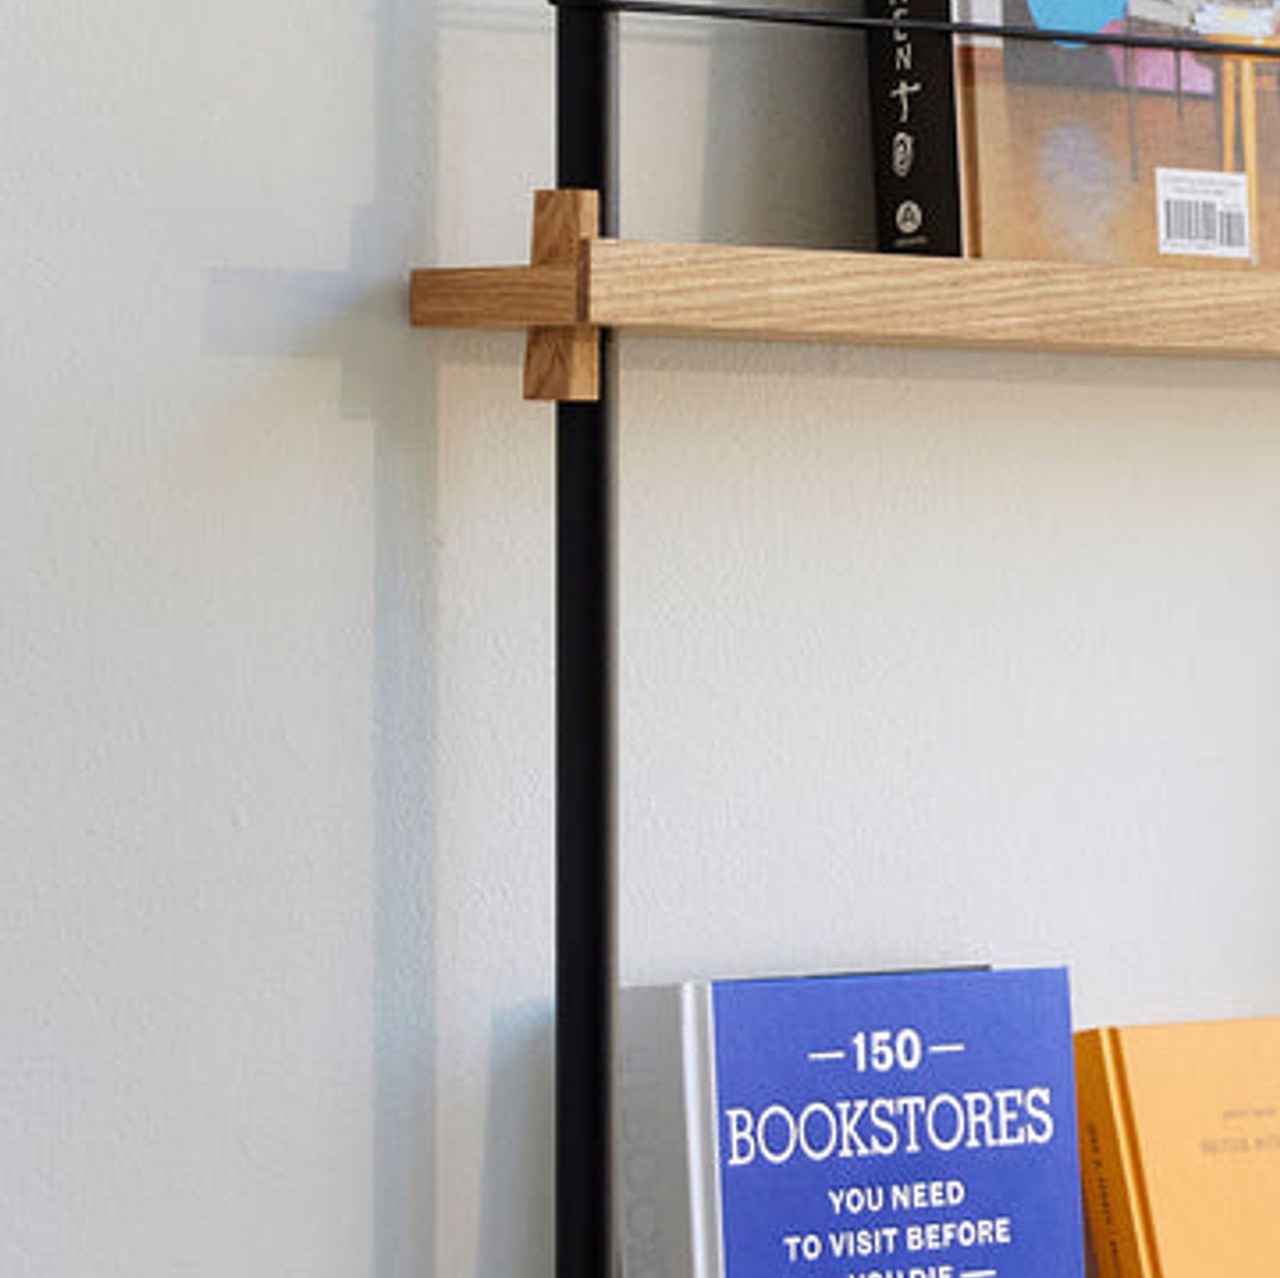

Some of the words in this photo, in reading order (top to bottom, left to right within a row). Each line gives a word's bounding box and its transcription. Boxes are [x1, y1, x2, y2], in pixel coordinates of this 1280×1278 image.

[726, 1087, 1054, 1166] BOOKSTORES
[828, 1186, 884, 1216] YOU
[892, 1180, 966, 1210] NEED
[783, 1234, 823, 1262] TO
[828, 1228, 898, 1259] VISIT
[906, 1218, 1012, 1251] BEFORE
